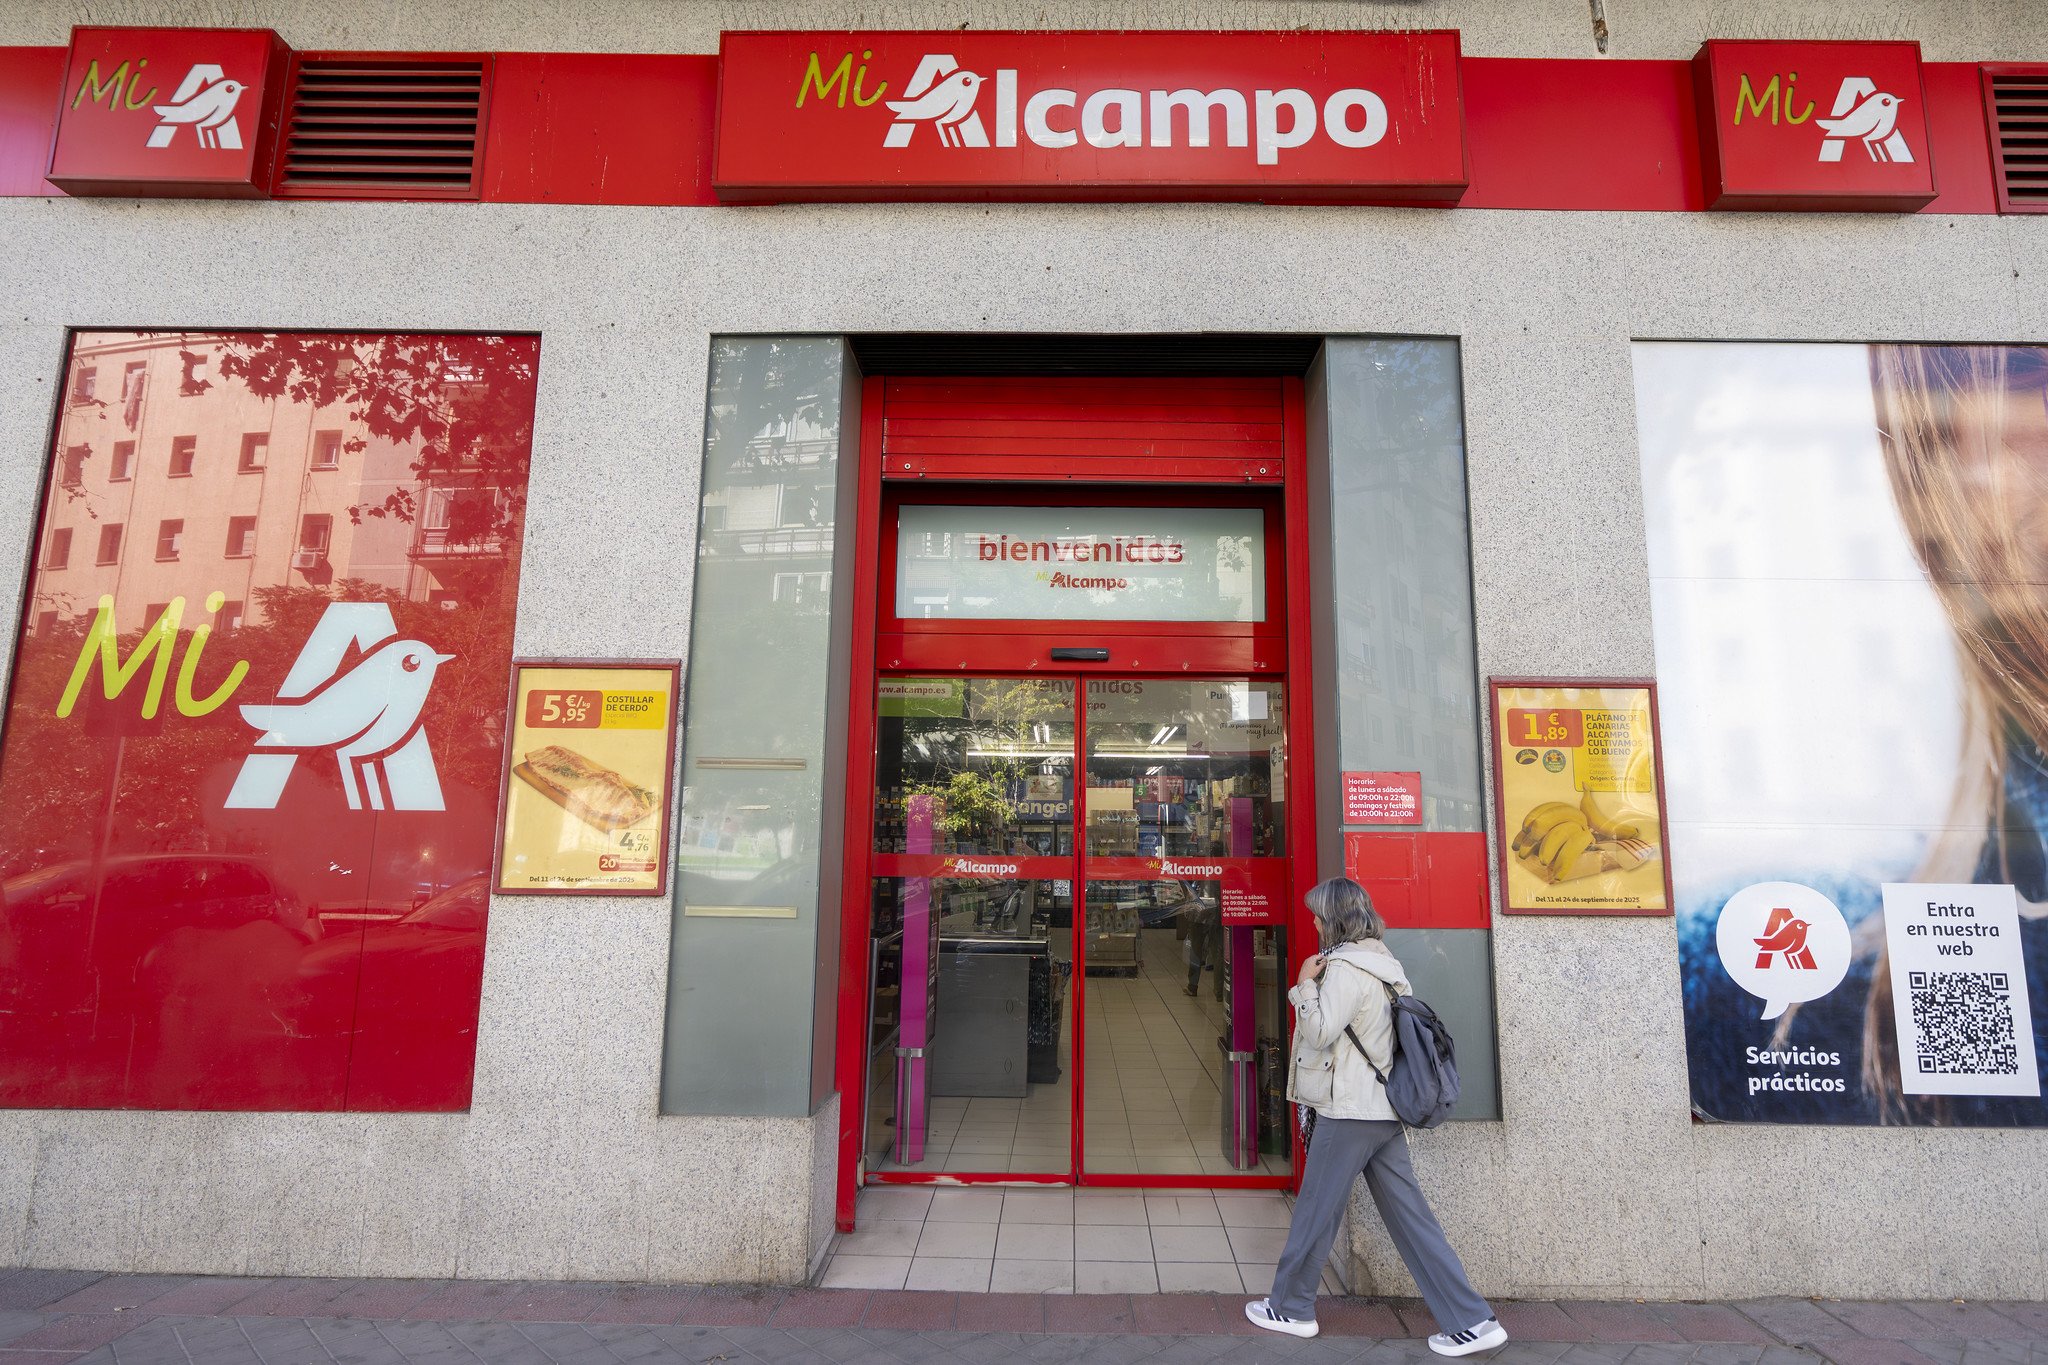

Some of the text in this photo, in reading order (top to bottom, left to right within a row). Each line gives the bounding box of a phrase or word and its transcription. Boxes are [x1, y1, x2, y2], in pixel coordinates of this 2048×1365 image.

[71, 57, 158, 112] Mi
[796, 49, 1388, 165] Mi Alcampo
[1734, 72, 1816, 126] Mi
[978, 535, 1185, 564] bienvenidos
[1050, 571, 1128, 591] Alcampo
[56, 590, 250, 720] Mi
[879, 685, 946, 695] ww.alcampo.es
[606, 696, 654, 704] COSTILLAR
[1586, 712, 1626, 721] PLÁTANO
[1349, 802, 1382, 810] domingos
[944, 857, 1017, 876] Mi Alcampo
[1160, 860, 1222, 877] Alcampo
[1926, 902, 1975, 918] Entra
[1906, 923, 2000, 938] en nuestra
[1936, 940, 1974, 956] web
[1746, 1046, 1841, 1066] Servicios
[1748, 1072, 1846, 1096] prácticos
